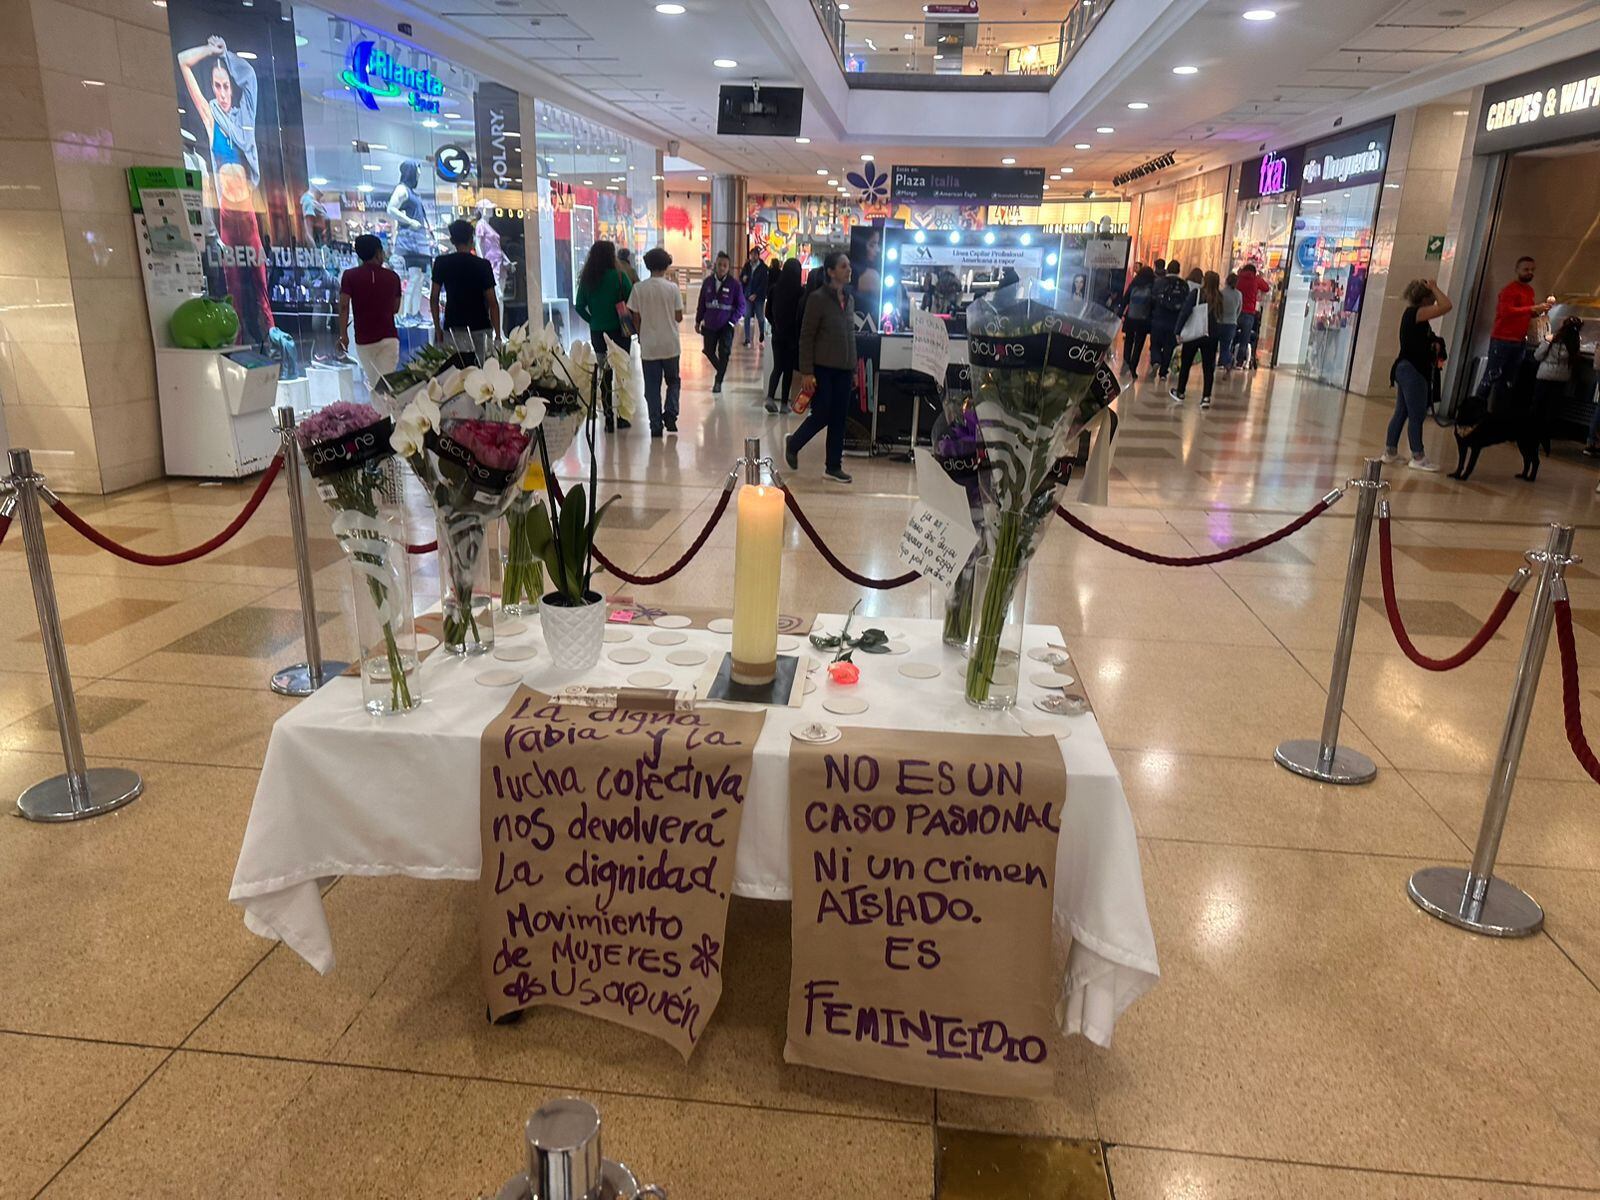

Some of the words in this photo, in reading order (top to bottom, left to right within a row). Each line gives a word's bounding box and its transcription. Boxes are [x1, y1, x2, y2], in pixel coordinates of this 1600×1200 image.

[1486, 92, 1543, 131] CREPES
[1543, 88, 1557, 118] &
[895, 174, 926, 187] Plaza
[271, 247, 292, 267] TU
[504, 723, 608, 759] rabia
[644, 727, 671, 770] y
[493, 760, 586, 802] lucha
[824, 753, 880, 794] NO
[493, 807, 555, 850] nos
[568, 801, 728, 848] devolverá
[805, 801, 896, 834] CASO
[906, 801, 1061, 837] PASIONAL
[813, 847, 852, 884] Ni
[506, 903, 683, 940] Movimiento
[493, 937, 532, 975] de
[885, 936, 941, 970] ES
[804, 980, 1048, 1064] FEMINICIDIO
